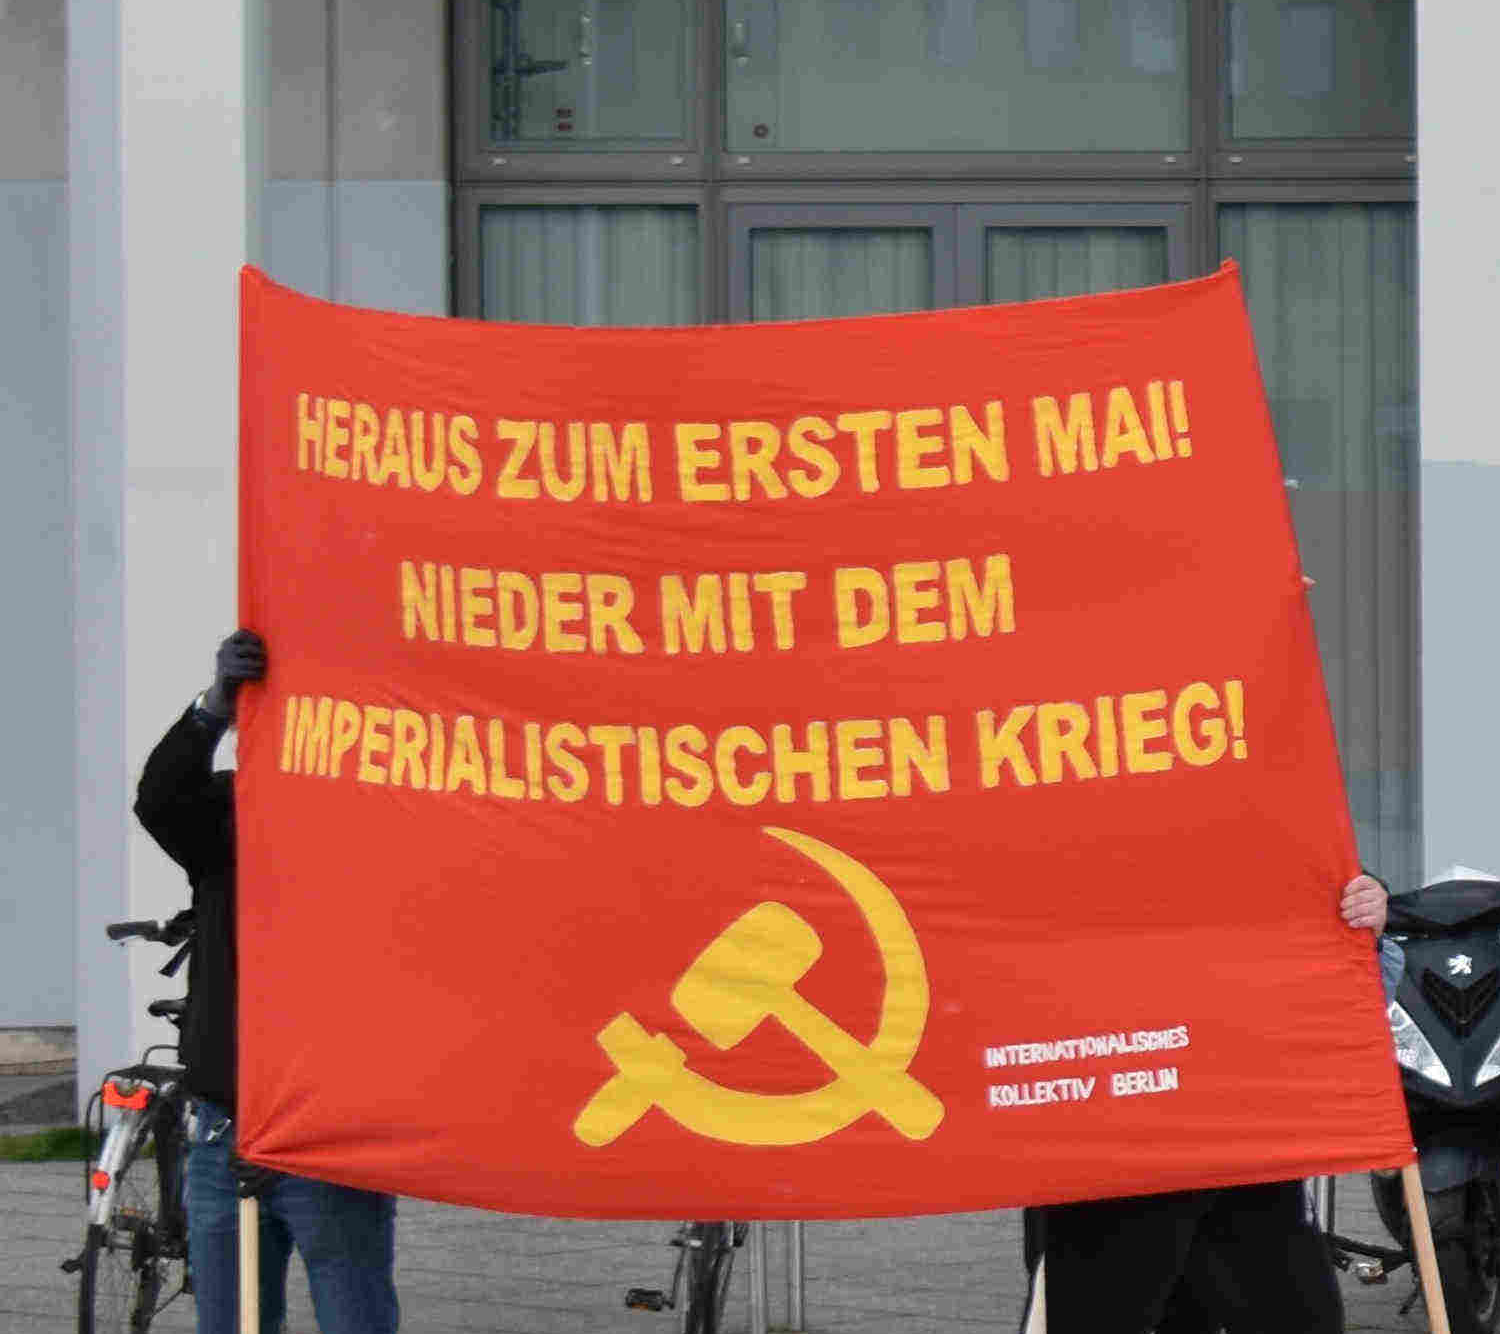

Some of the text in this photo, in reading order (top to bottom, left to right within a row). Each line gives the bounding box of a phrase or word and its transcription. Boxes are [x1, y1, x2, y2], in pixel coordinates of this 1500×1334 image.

[298, 380, 1193, 503] HERAUS ZUM ERSTEN MAI!
[401, 553, 1015, 655] NIEDER MIT DEM
[280, 679, 1248, 808] IMPERIALISTISCHEN KRIEG!
[989, 1066, 1180, 1107] KOLLEKTIV BERLIN
